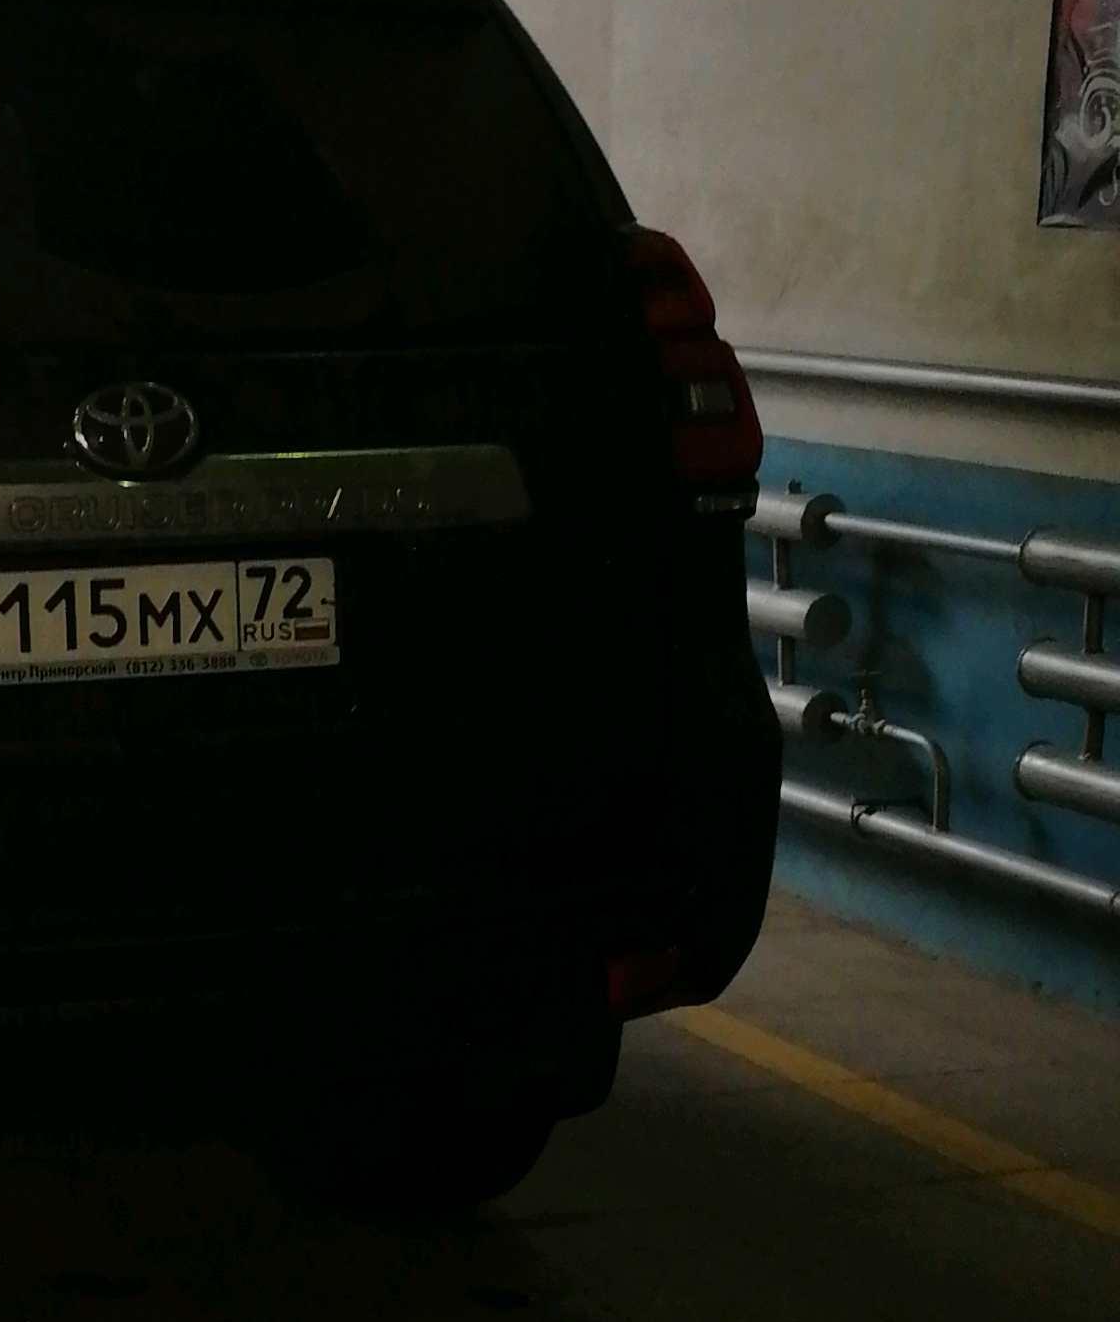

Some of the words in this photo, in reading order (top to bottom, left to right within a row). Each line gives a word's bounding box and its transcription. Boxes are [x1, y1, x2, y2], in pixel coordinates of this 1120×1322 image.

[246, 566, 313, 621] 72
[243, 622, 291, 642] RUS
[126, 658, 164, 675] (812)
